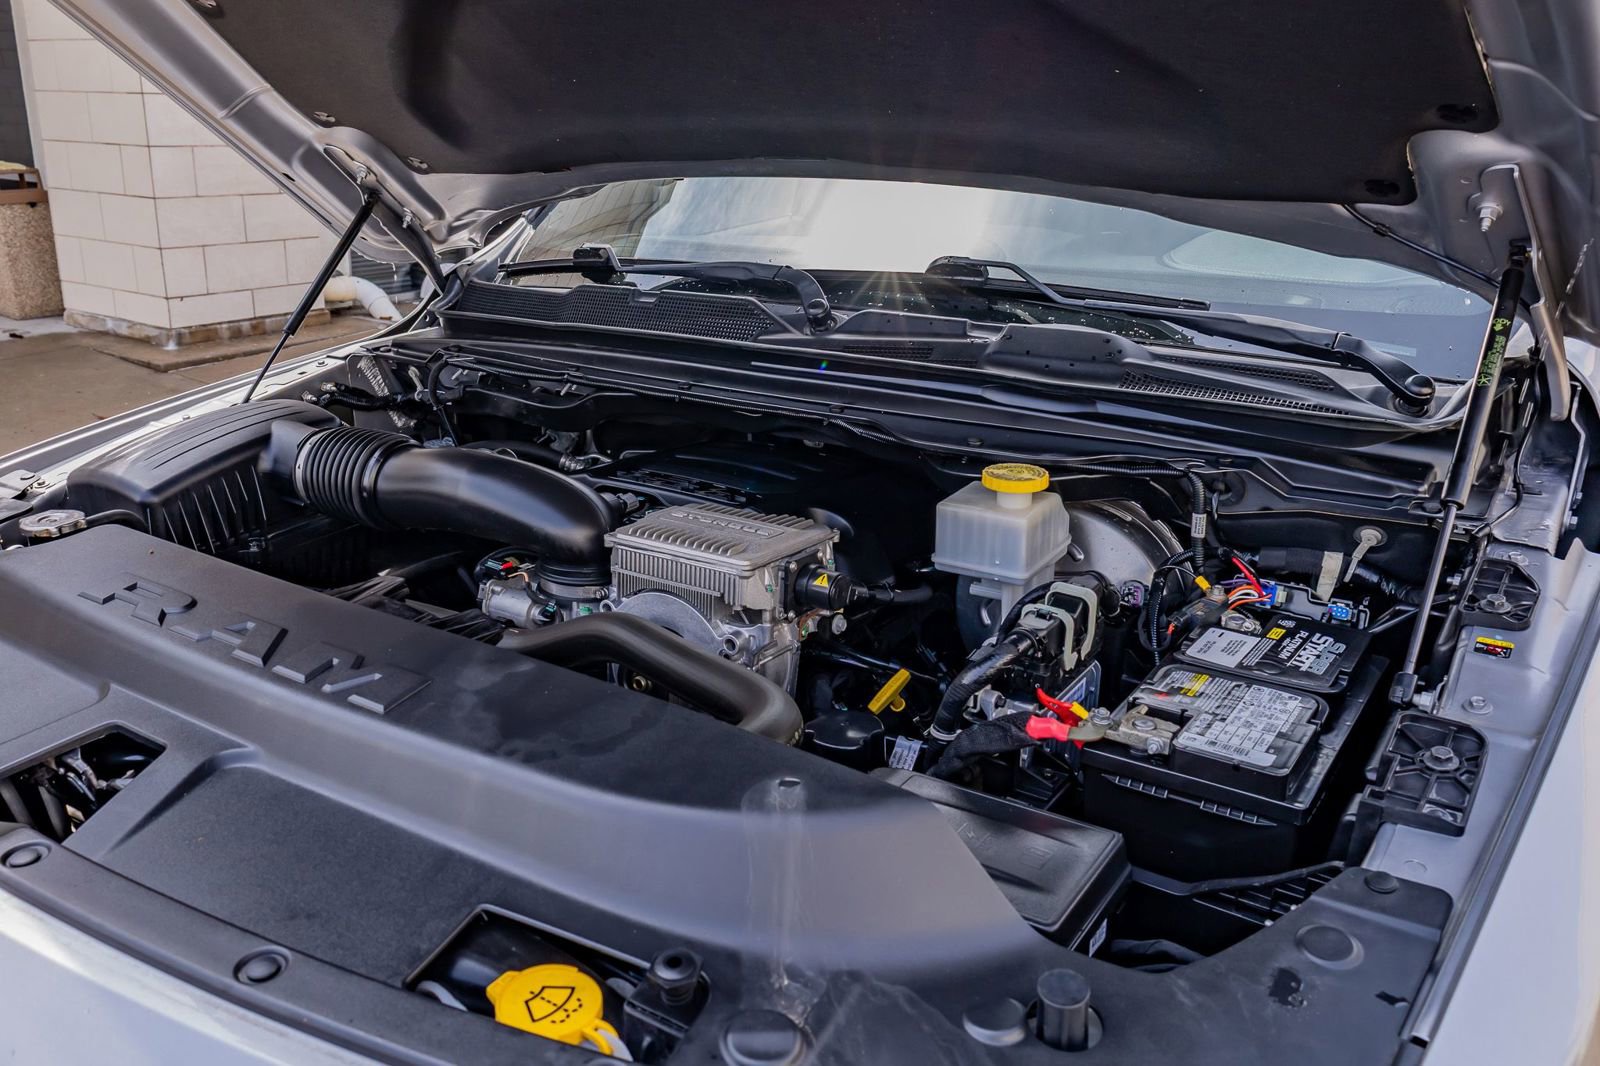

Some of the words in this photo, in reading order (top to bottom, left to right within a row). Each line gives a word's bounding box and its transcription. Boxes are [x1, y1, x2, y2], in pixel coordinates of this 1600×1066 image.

[77, 571, 433, 715] RAM
[1278, 630, 1309, 660] PLATINUM
[1292, 632, 1334, 671] START
[1307, 641, 1347, 675] SUPER
